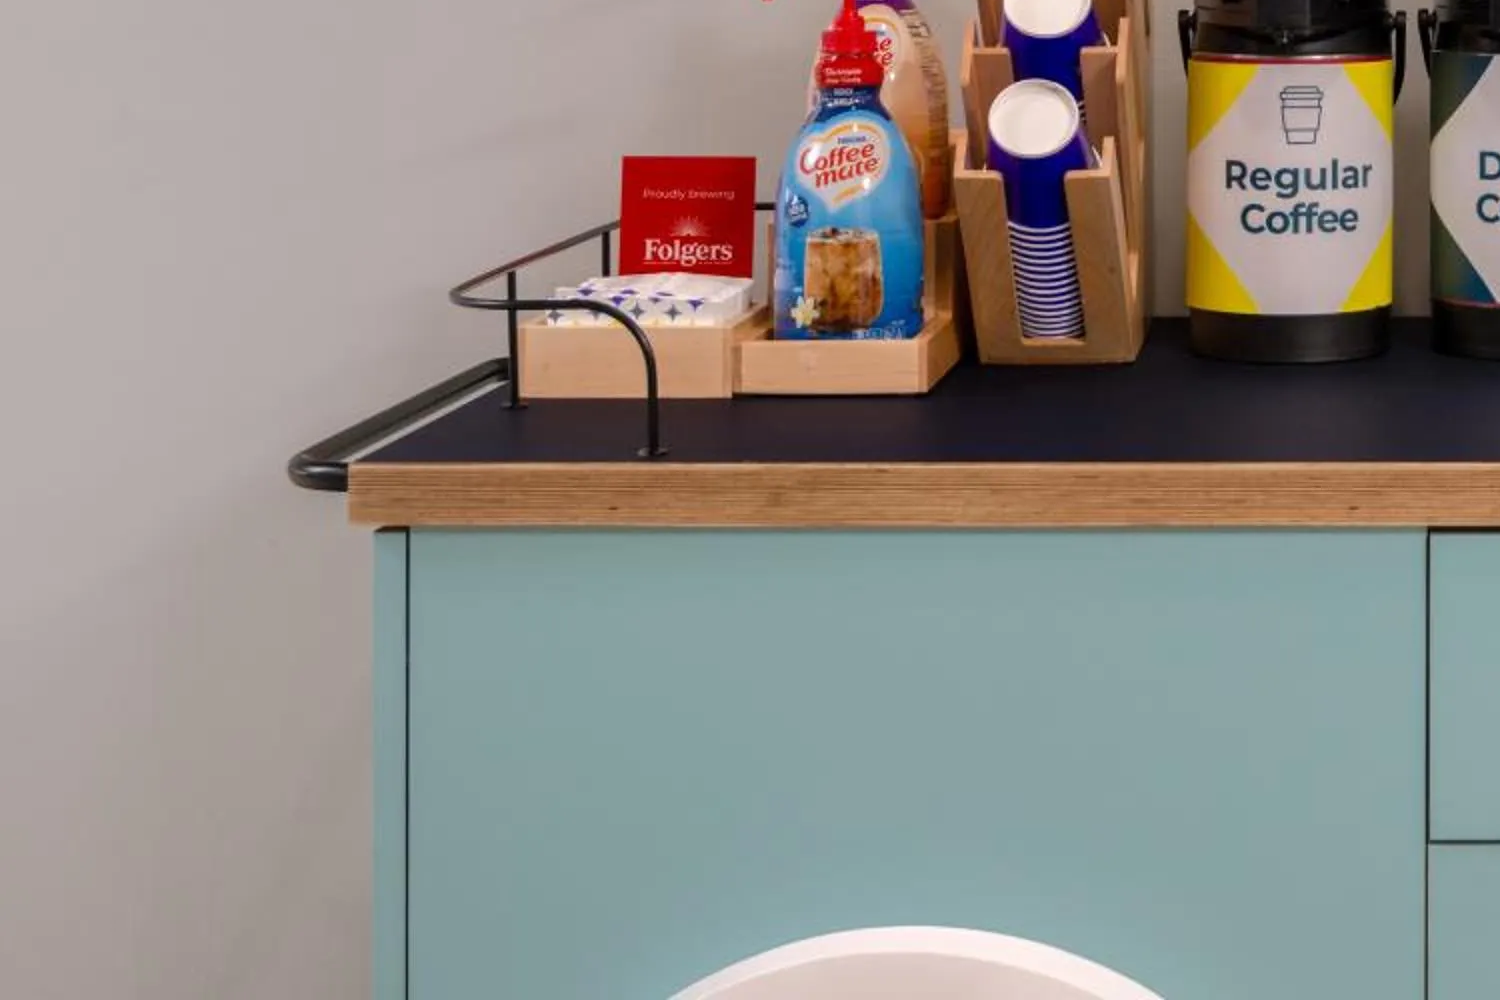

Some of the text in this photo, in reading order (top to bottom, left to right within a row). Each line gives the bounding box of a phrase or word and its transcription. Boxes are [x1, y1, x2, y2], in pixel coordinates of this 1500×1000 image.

[799, 143, 875, 175] Coffee
[815, 157, 878, 188] mate
[642, 188, 686, 200] Proudly
[1225, 158, 1372, 199] Regular
[1240, 202, 1359, 234] Coffee
[643, 238, 734, 267] Folgers
